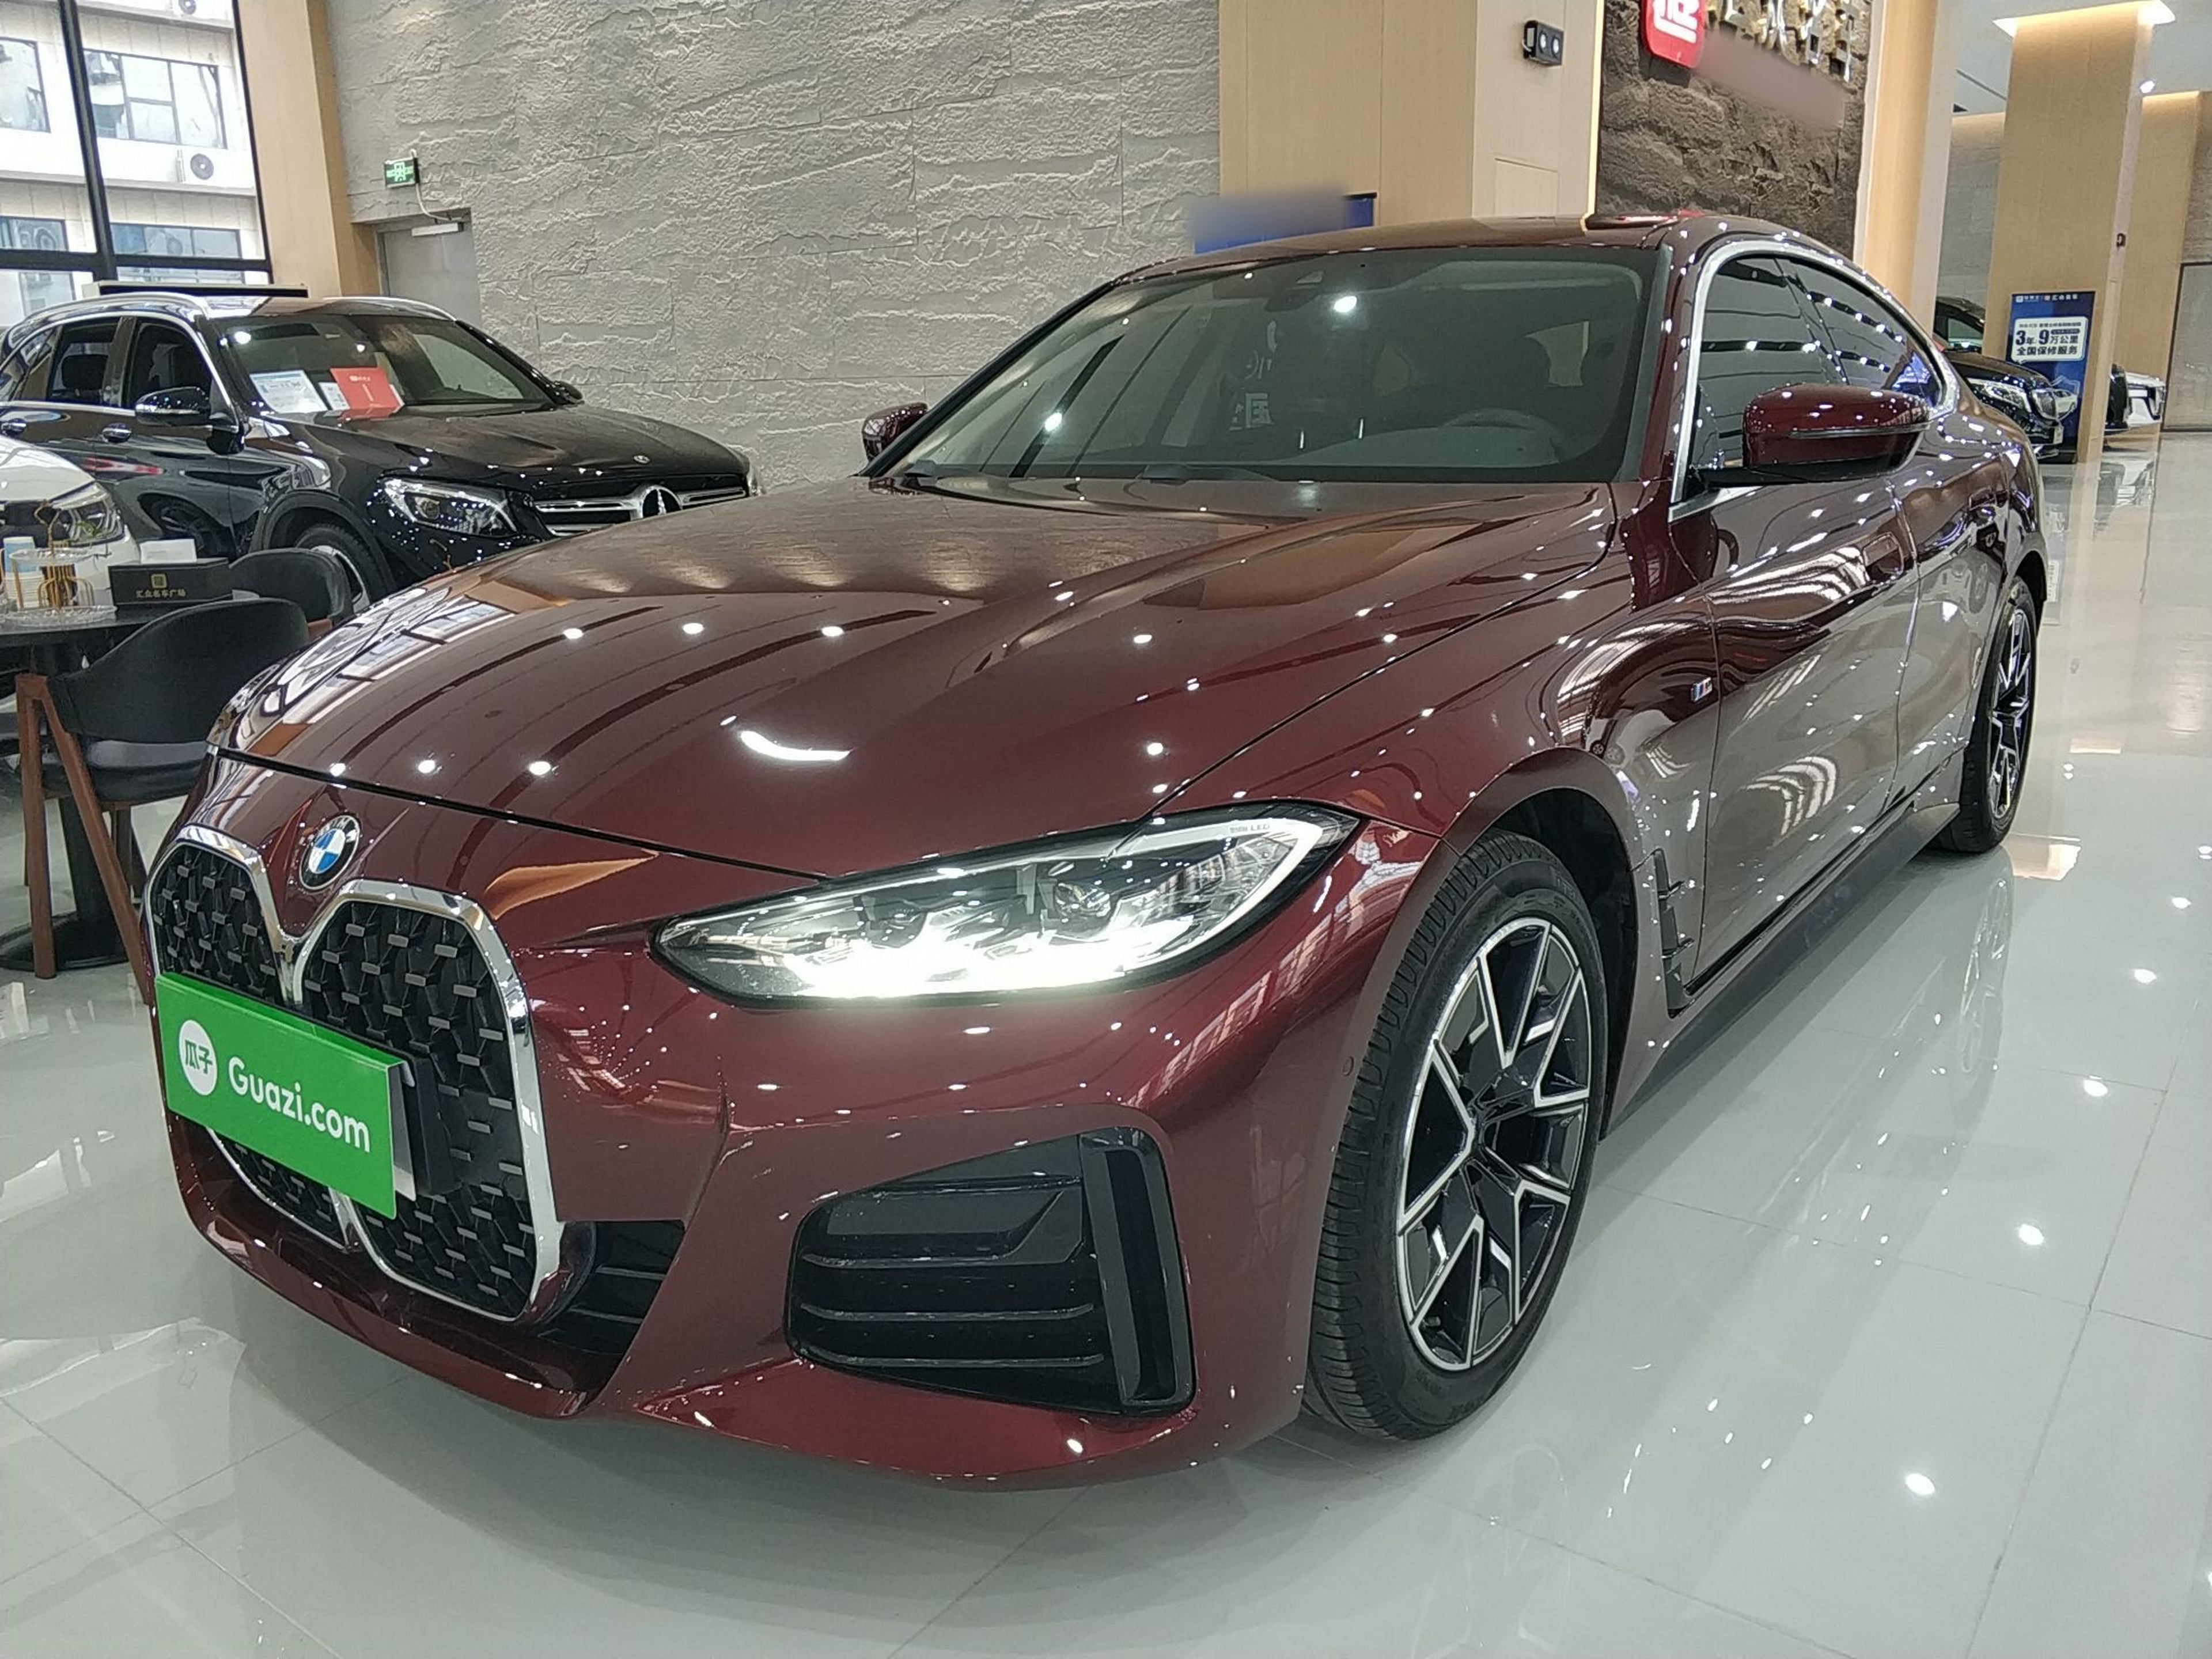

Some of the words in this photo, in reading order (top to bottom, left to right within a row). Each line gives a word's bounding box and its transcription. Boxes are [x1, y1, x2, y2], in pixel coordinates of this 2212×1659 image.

[2017, 346, 2077, 355] 全国保修服务
[185, 1039, 213, 1074] 瓜子
[228, 1056, 370, 1153] Guazi.com
